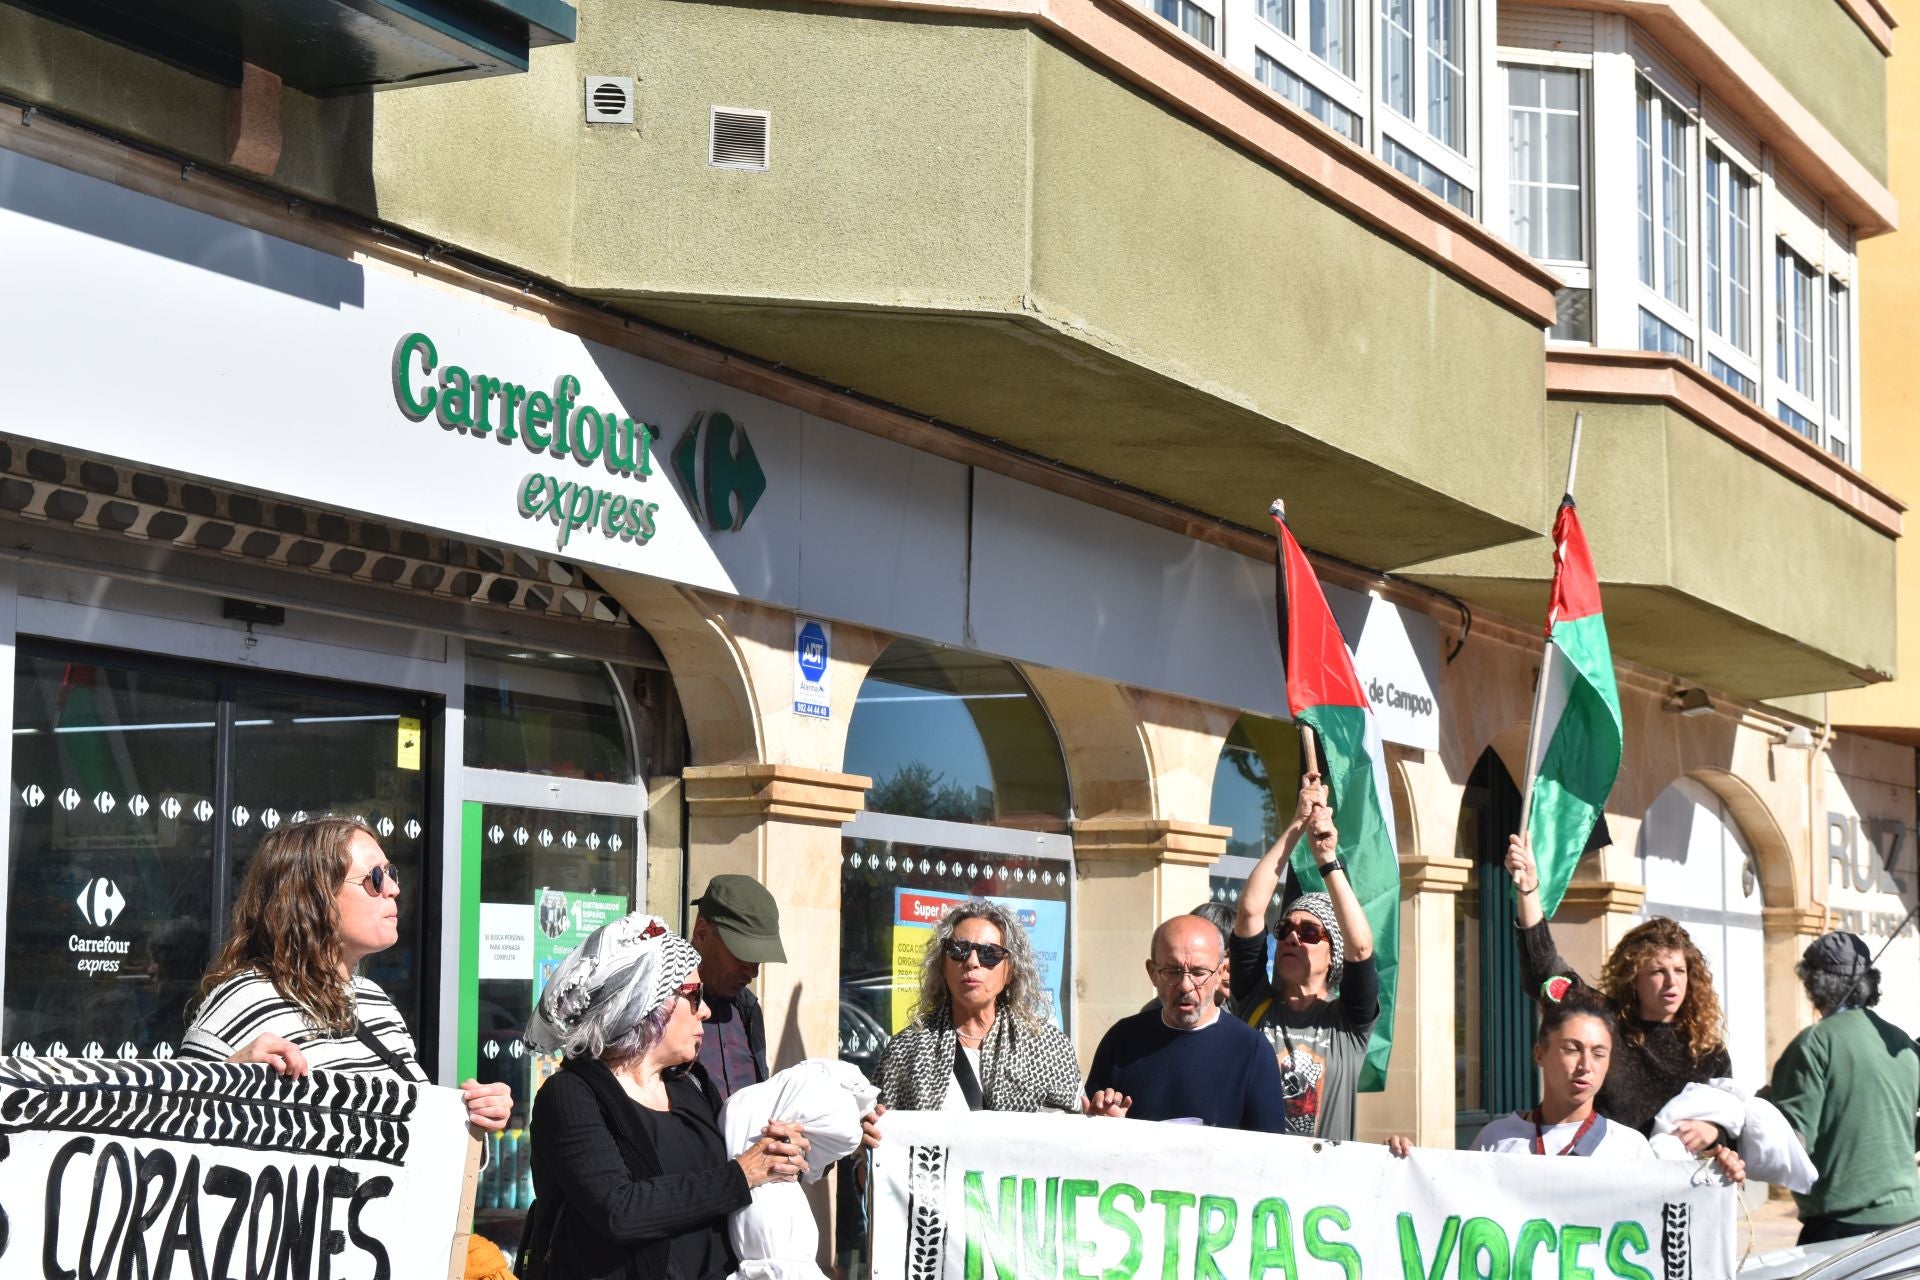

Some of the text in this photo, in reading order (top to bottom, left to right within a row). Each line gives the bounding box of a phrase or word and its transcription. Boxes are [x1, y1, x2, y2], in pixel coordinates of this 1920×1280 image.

[394, 332, 660, 481] Carrefour
[518, 473, 659, 550] express
[803, 642, 823, 664] ADT
[807, 704, 813, 713] 44
[814, 706, 820, 715] 44
[1369, 677, 1432, 718] de Campoo
[1827, 811, 1906, 893] RUIZ
[914, 900, 940, 919] Super
[69, 935, 130, 954] Carrefour
[504, 934, 525, 942] PERSONAL
[897, 943, 914, 953] COCA
[77, 958, 120, 977] express
[42, 1136, 394, 1280] CORAZONES
[964, 1170, 1363, 1280] NUESTRAS
[1396, 1211, 1656, 1280] VOCES
